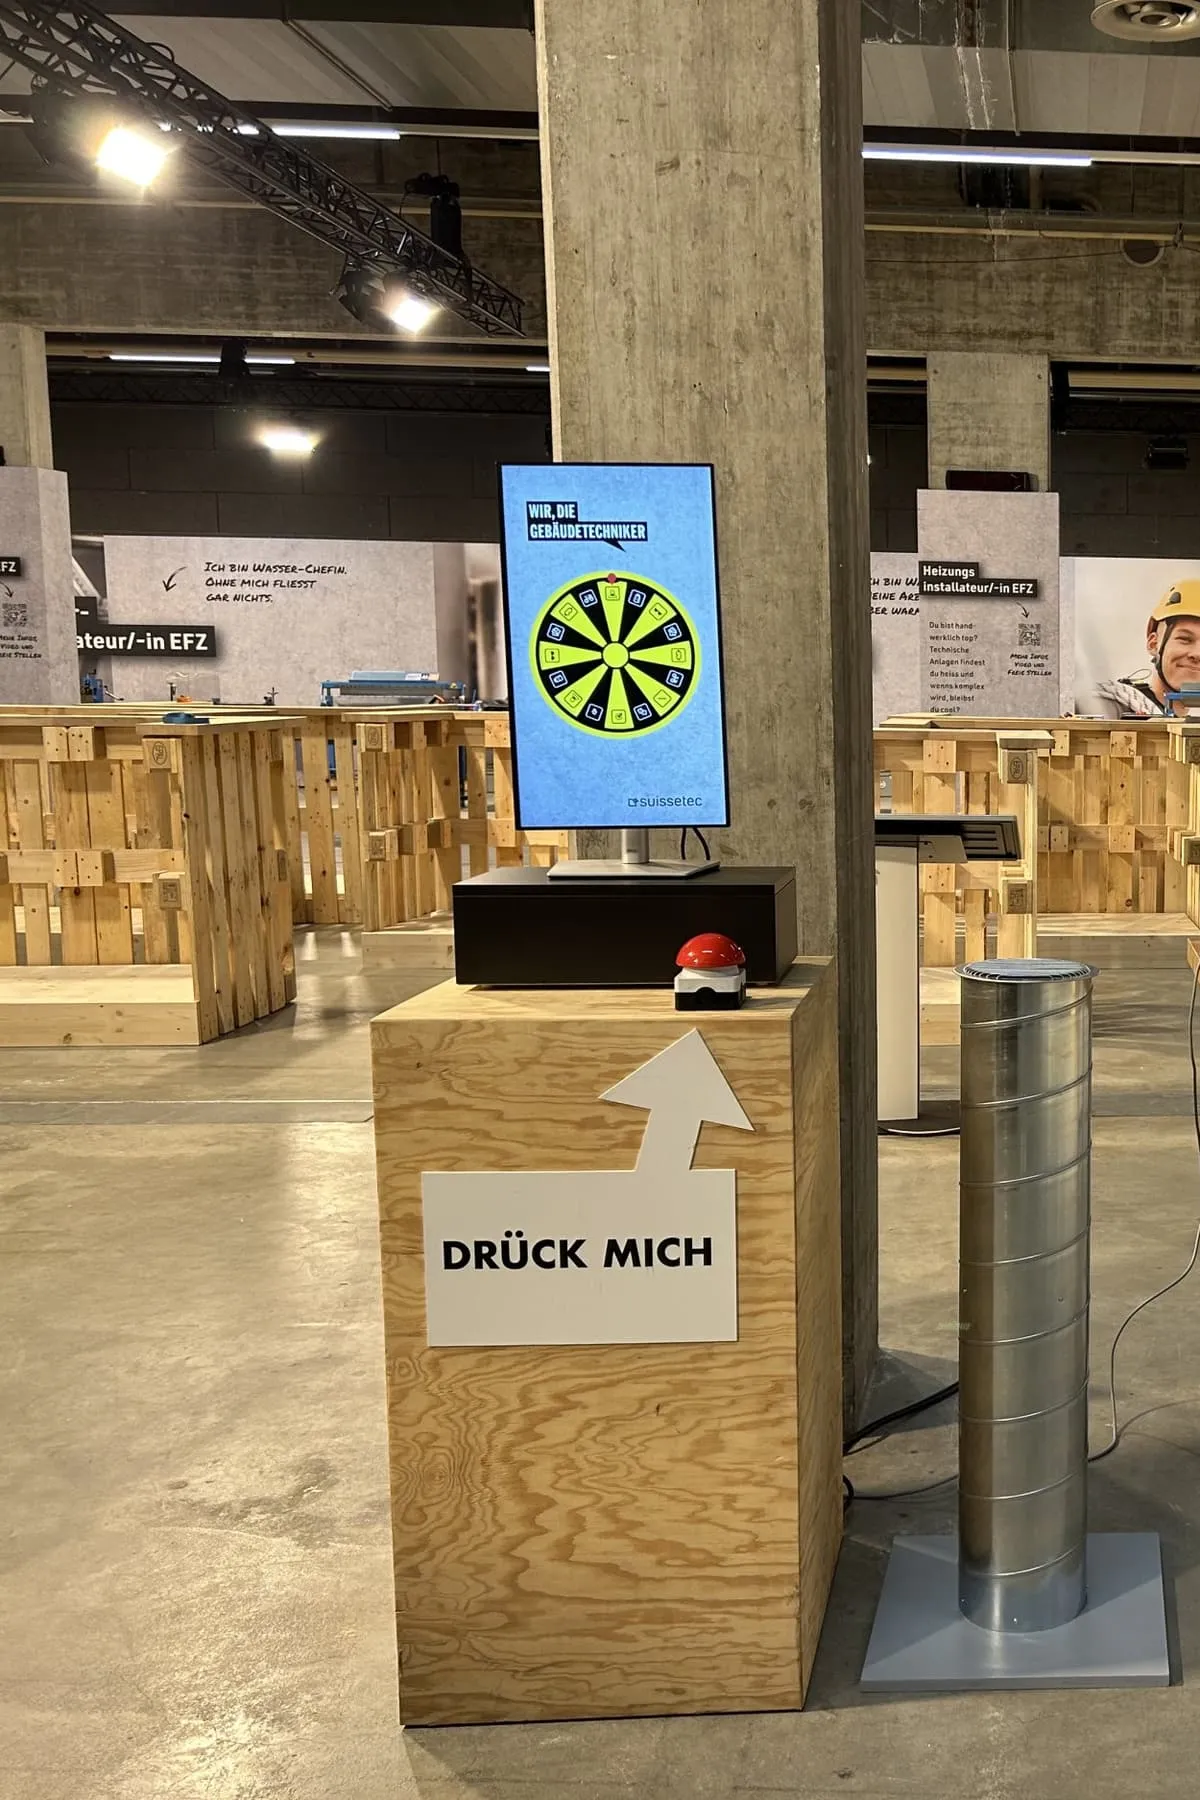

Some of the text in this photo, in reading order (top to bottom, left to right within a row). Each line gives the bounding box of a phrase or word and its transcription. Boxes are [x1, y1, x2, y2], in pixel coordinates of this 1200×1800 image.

[528, 504, 576, 520] WIR, DIE
[530, 521, 646, 539] GEBÄUDETECHNIKER
[0, 561, 16, 572] FZ
[204, 562, 347, 575] ICH BIN WASSER-CHEFIN.
[923, 565, 975, 580] Heizungs
[205, 577, 317, 588] OHNE MICH FLIESST
[883, 577, 902, 586] BIN
[923, 581, 1033, 594] installateur/-in EFZ
[206, 593, 230, 602] GAR
[929, 621, 939, 629] Du
[169, 632, 208, 650] EFZ
[961, 634, 978, 642] top?
[930, 646, 970, 654] Technische
[930, 659, 959, 667] Anlagen
[954, 683, 985, 691] komplex
[639, 796, 703, 807] suissetec
[443, 1230, 712, 1270] DRÜCK MICH
